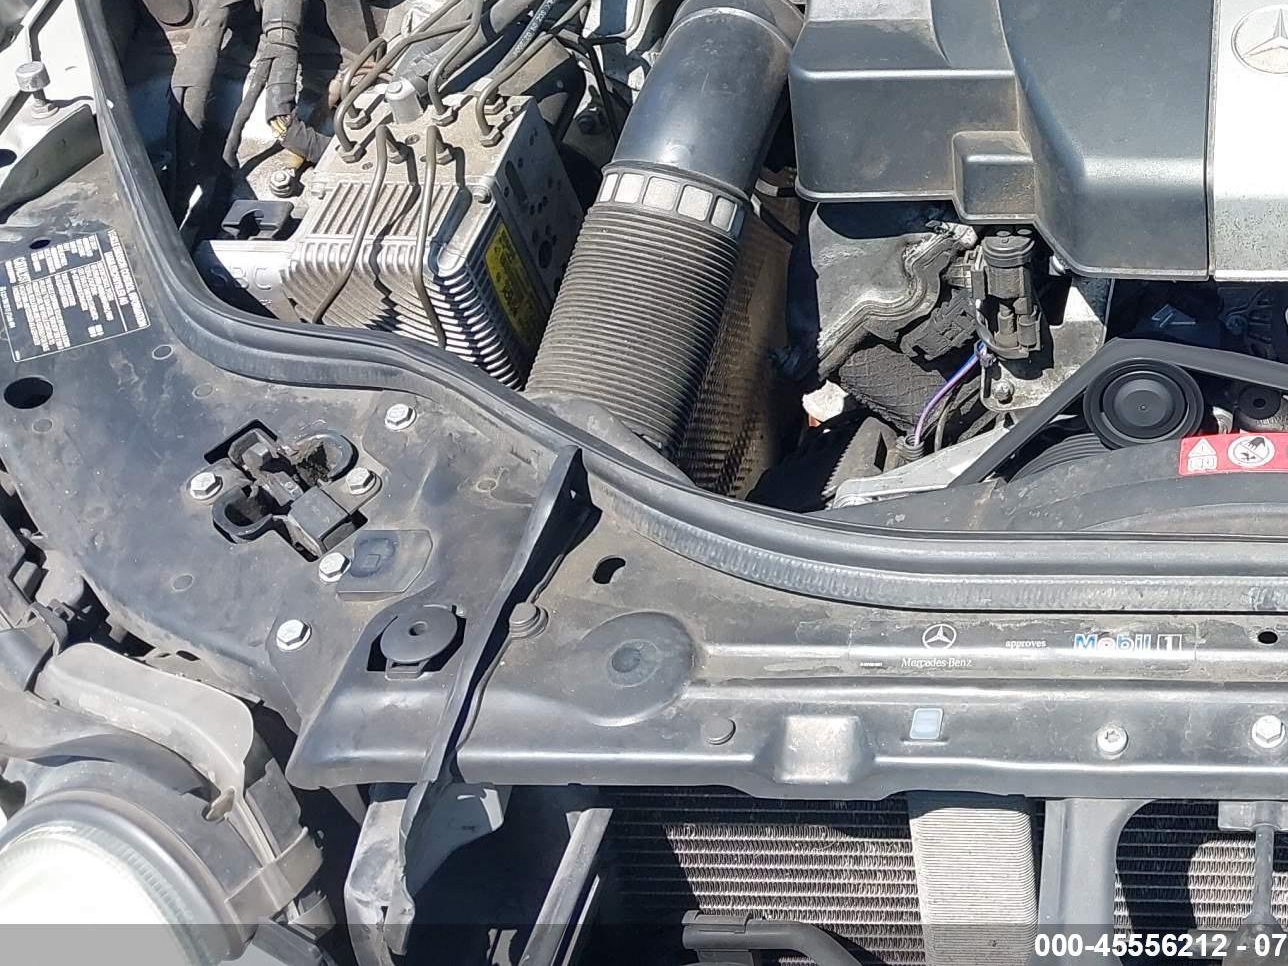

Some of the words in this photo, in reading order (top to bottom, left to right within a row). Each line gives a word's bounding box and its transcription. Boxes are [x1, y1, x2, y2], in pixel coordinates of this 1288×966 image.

[121, 268, 135, 293] CONTROL
[1005, 639, 1046, 648] approves
[1074, 634, 1151, 651] Mobil
